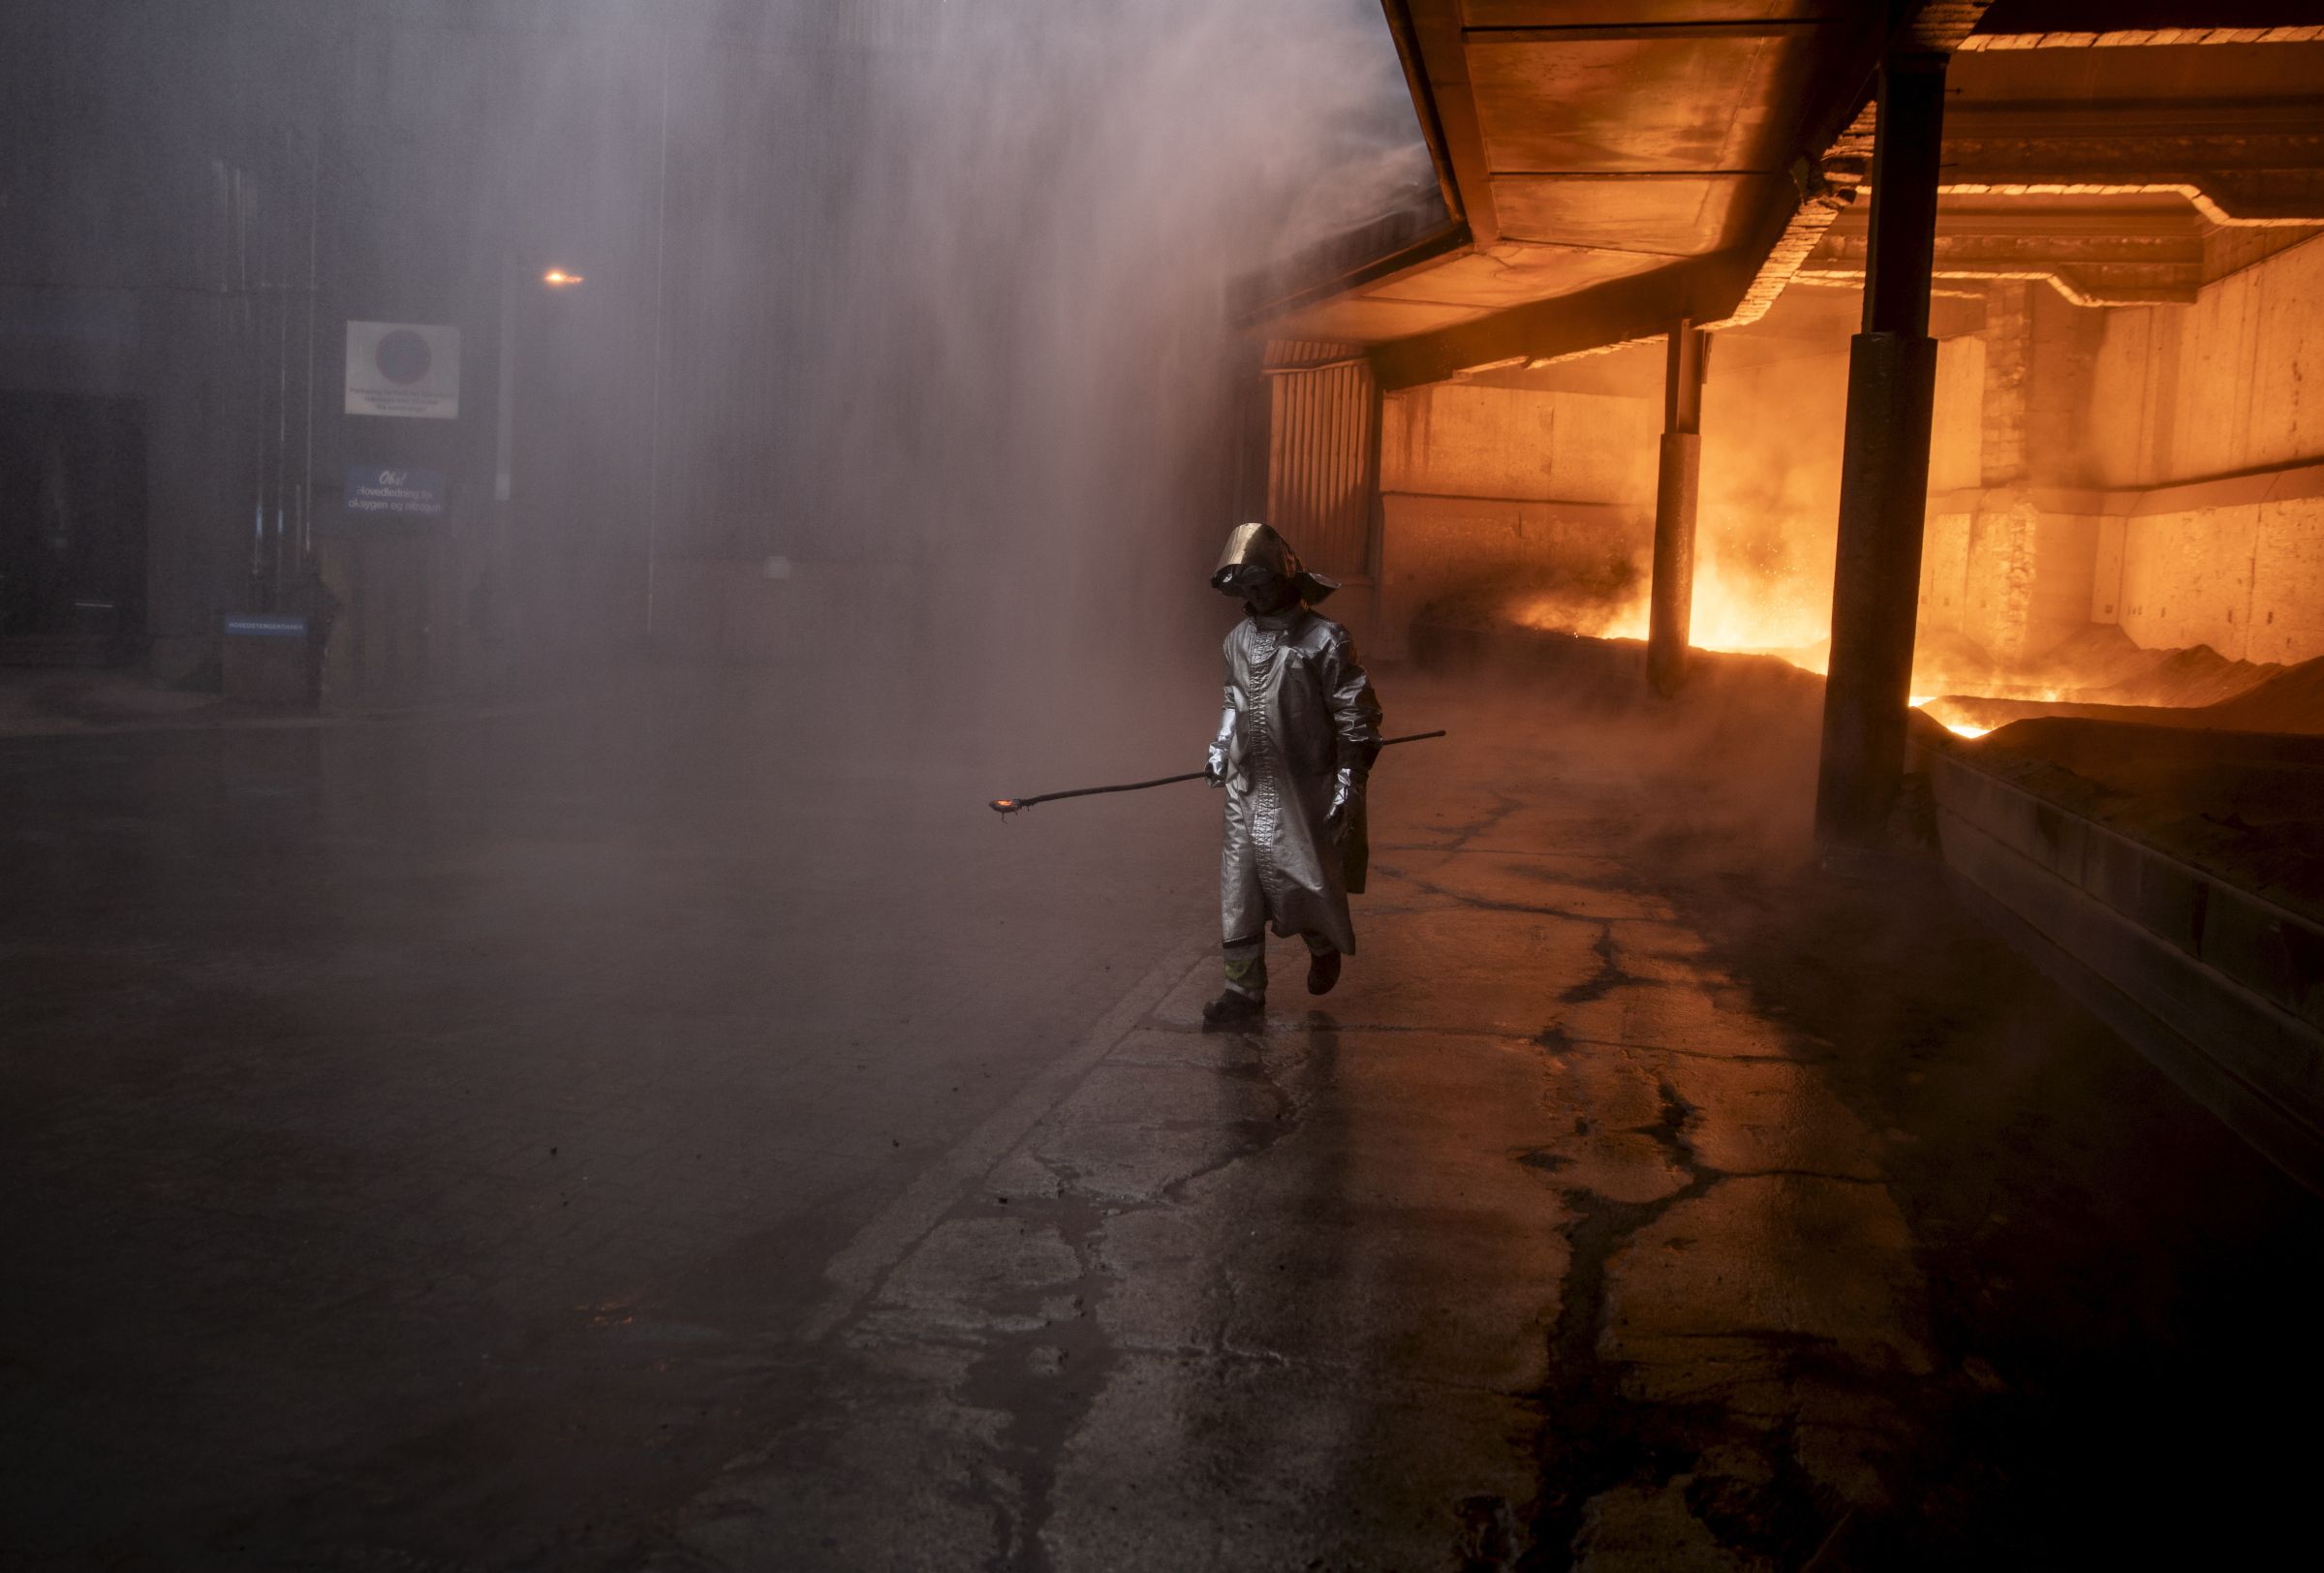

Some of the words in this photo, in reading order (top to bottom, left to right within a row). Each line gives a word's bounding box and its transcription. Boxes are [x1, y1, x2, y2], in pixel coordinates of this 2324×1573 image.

[349, 498, 387, 510] oksygen
[390, 502, 403, 511] og
[405, 501, 441, 512] nitrogen
